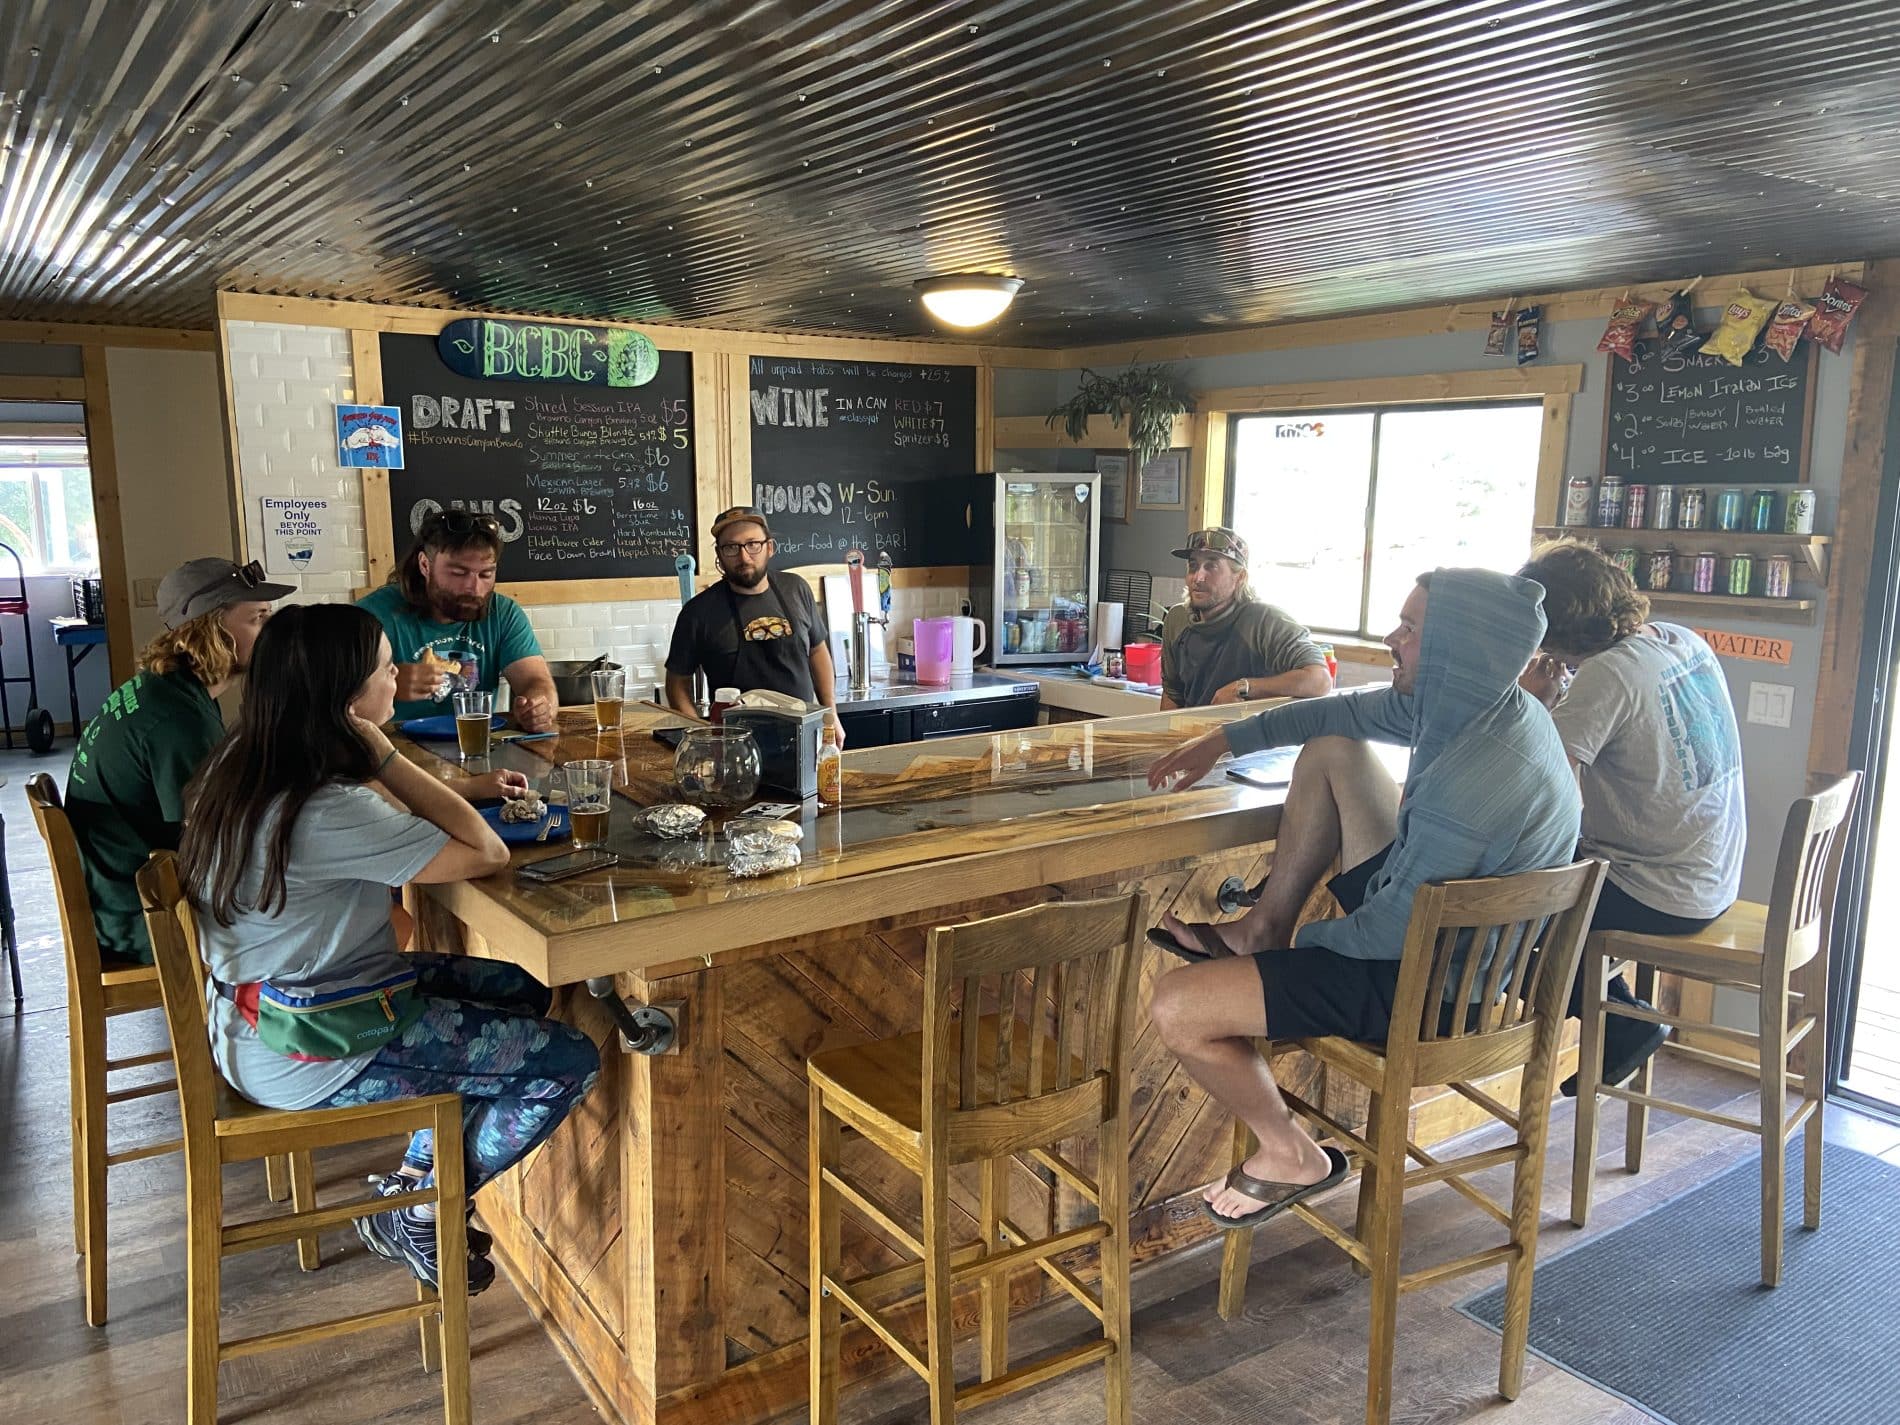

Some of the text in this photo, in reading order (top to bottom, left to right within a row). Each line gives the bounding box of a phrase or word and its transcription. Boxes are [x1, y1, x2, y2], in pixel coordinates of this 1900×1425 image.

[483, 320, 596, 382] BCBC
[751, 358, 764, 375] All
[771, 362, 803, 381] unpaid
[811, 363, 834, 376] tabs
[843, 365, 860, 377] will
[866, 367, 877, 377] be
[882, 367, 913, 383] charged
[1765, 374, 1798, 392] ICE
[524, 393, 568, 414] Shred
[573, 394, 615, 414] Session
[660, 396, 689, 427] $5
[750, 385, 829, 428] WINE
[835, 396, 888, 411] IN A CAN
[894, 400, 921, 412] RED
[411, 394, 516, 434] DRAFT
[605, 414, 638, 429] Brewing
[527, 421, 569, 440] Shuttle
[600, 424, 636, 439] Blonde
[894, 416, 928, 430] WHITE
[894, 431, 933, 447] Spritzer
[528, 447, 581, 464] Summer
[644, 445, 670, 468] $6
[1660, 448, 1708, 465] ICE
[1763, 445, 1790, 464] bag
[525, 473, 574, 489] Mexican
[575, 476, 604, 490] Lager
[645, 470, 669, 493] $6
[265, 498, 328, 511] Employees
[572, 498, 597, 515] $6
[755, 482, 833, 516] HOURS
[284, 510, 310, 522] Only
[409, 498, 525, 543] CS
[670, 508, 685, 521] $6
[275, 528, 322, 536] THIS POINT
[280, 521, 317, 529] BEYOND
[616, 529, 636, 538] Hard
[527, 535, 606, 548] Elderflower Cider
[808, 531, 833, 551] food
[838, 537, 848, 549] @
[851, 531, 869, 551] the
[875, 528, 908, 551] BAR!
[528, 550, 553, 561] Face
[557, 549, 587, 560] Down
[1703, 631, 1785, 660] WATER
